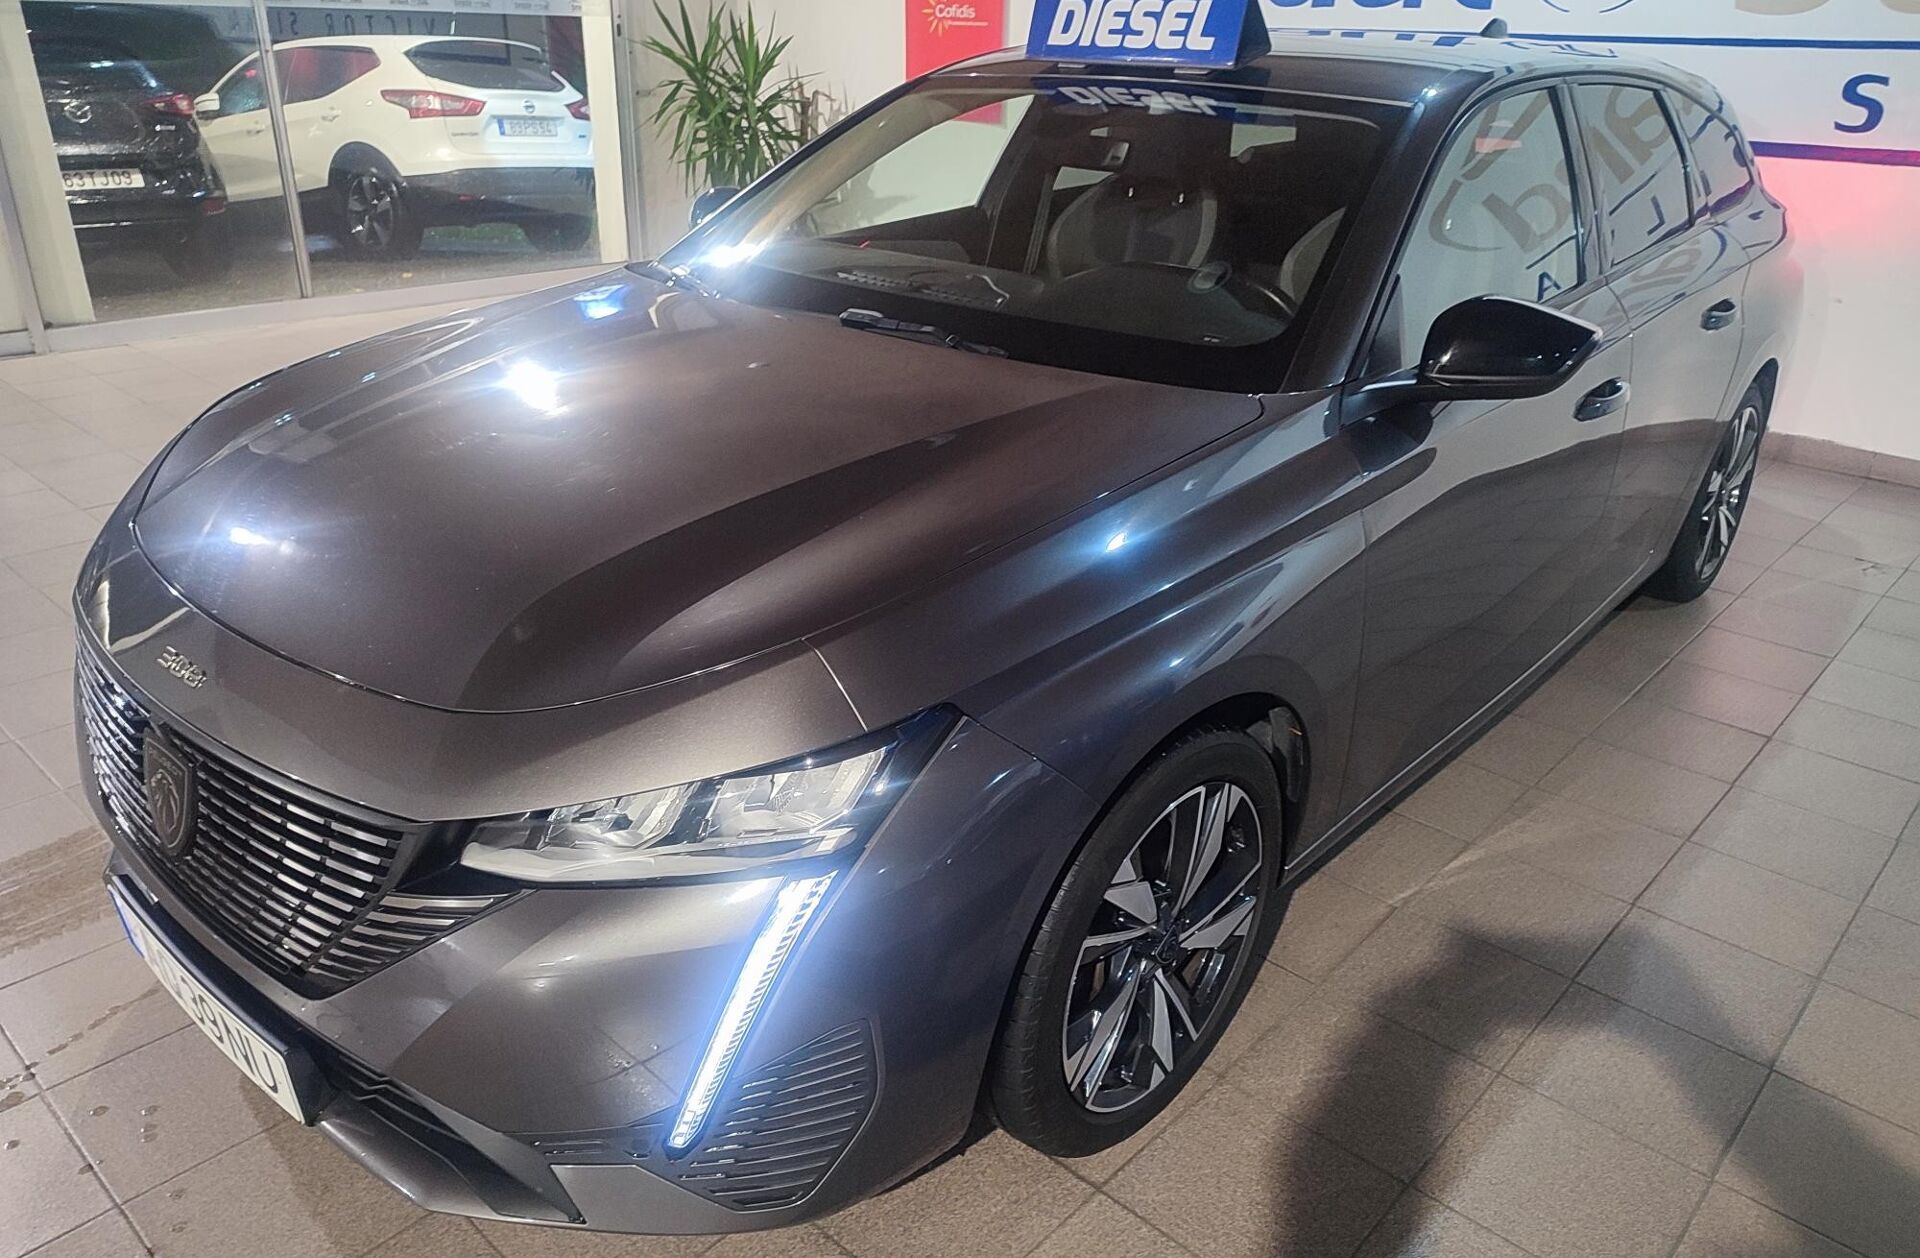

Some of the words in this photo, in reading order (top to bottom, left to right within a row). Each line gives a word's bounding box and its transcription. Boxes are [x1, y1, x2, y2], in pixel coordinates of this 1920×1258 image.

[935, 4, 976, 18] Cofidis
[1047, 0, 1215, 50] DIESEL
[1834, 74, 1890, 133] S
[156, 646, 207, 689] 308
